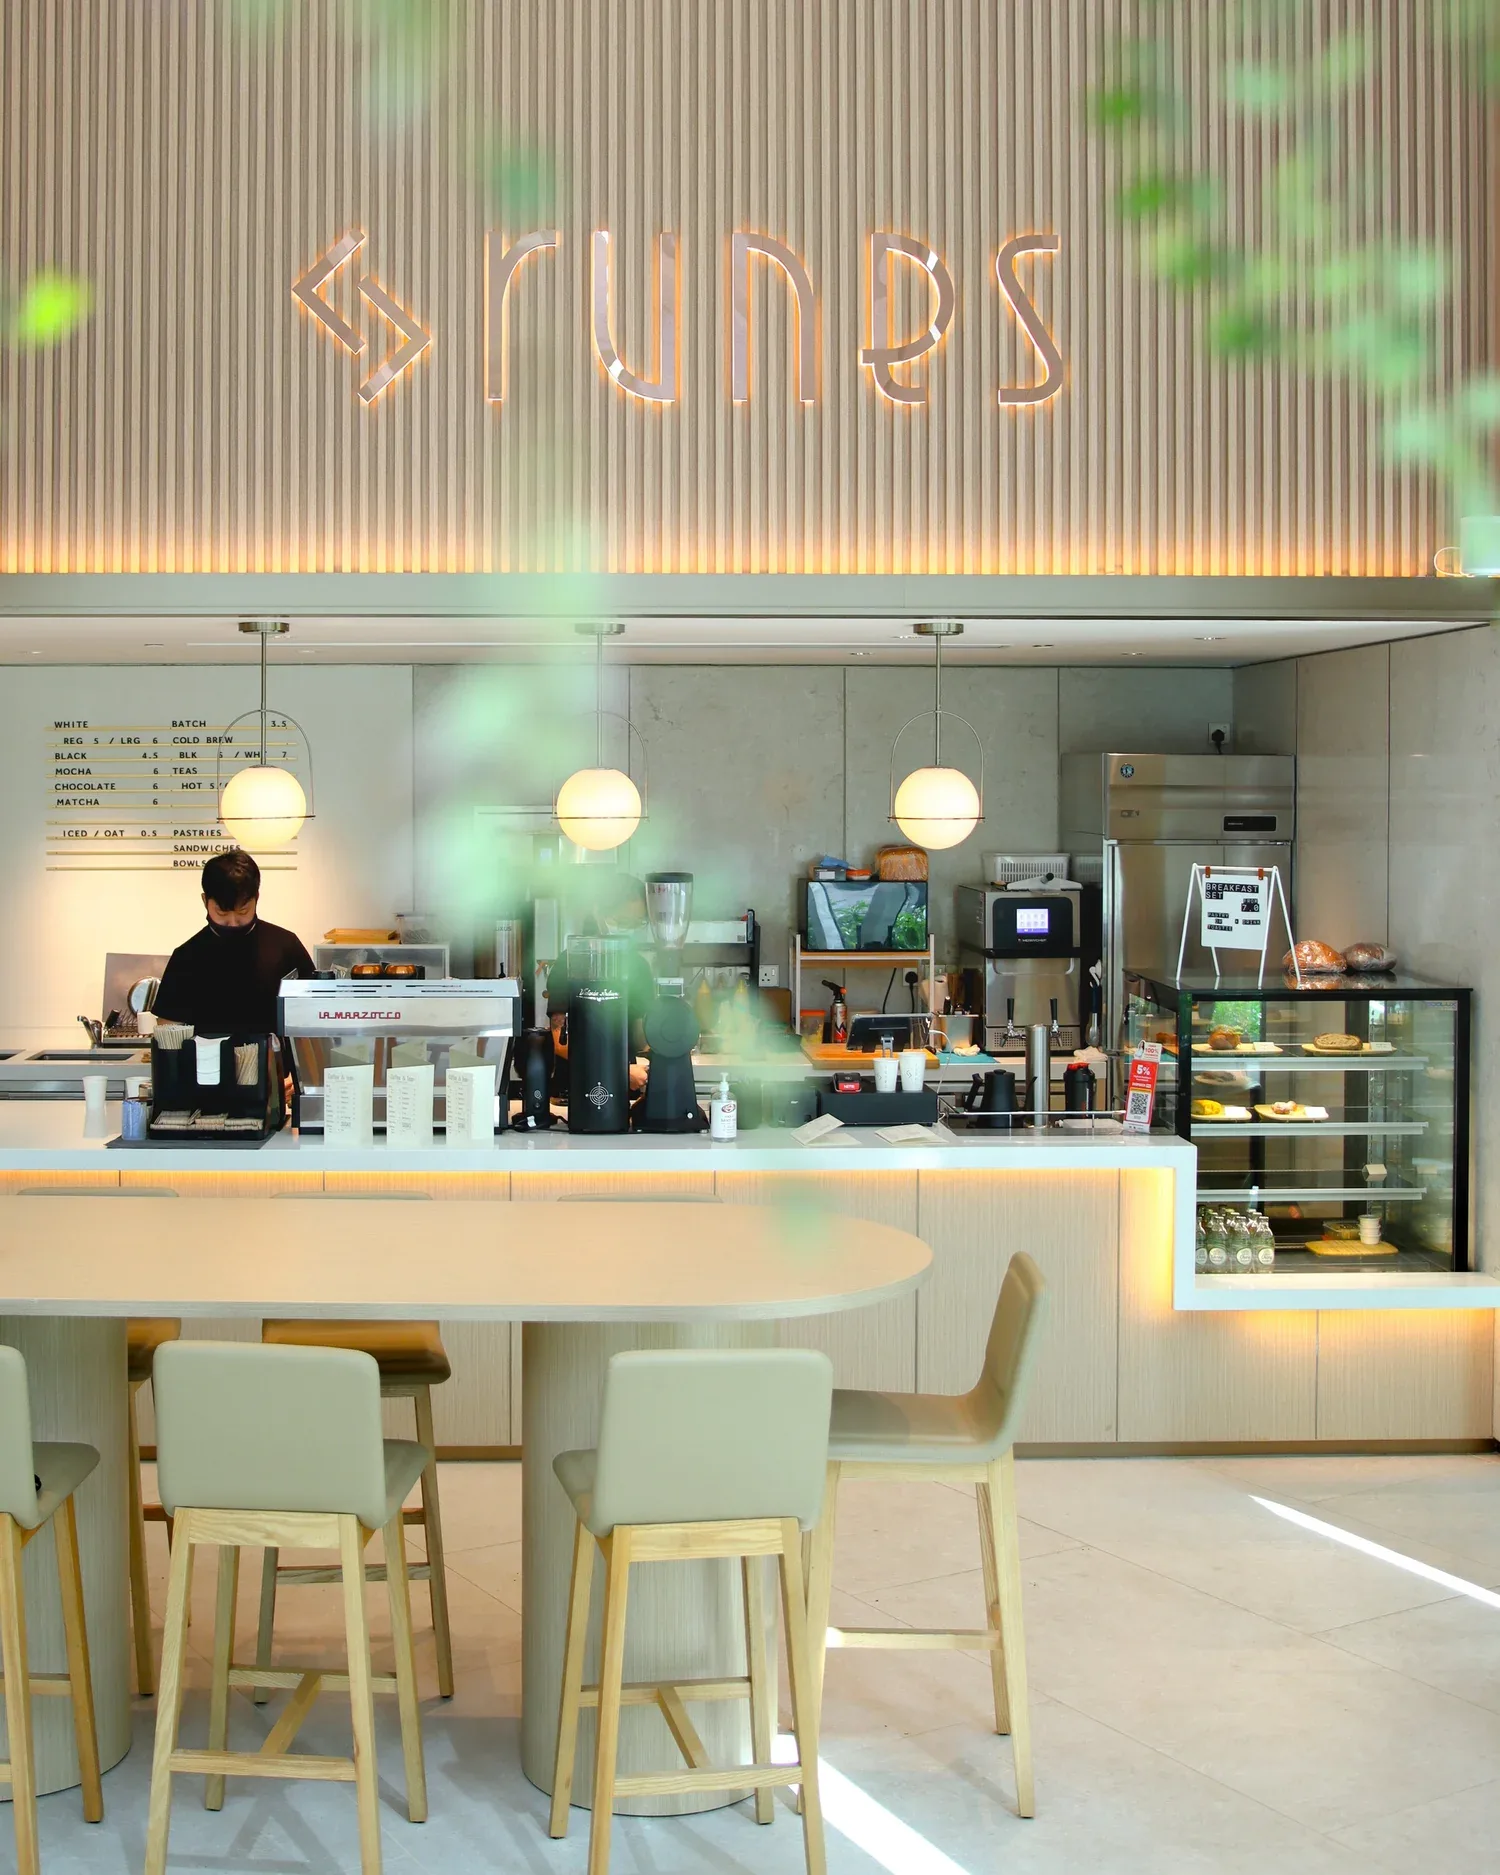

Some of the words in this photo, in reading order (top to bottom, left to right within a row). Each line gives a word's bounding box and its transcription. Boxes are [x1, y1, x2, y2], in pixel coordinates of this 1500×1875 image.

[173, 736, 200, 744] COLD
[206, 736, 233, 744] BREW
[153, 767, 159, 775] 6
[172, 767, 198, 775] TEAS
[152, 782, 158, 790] 6
[181, 782, 202, 790] HOT
[56, 798, 100, 806] MATCHA
[152, 798, 158, 806] 6
[173, 829, 221, 837] PASTRIES
[173, 844, 240, 852] SANDWICHES
[173, 859, 206, 867] BOWLS
[1206, 883, 1258, 893] BREAKFAST
[1205, 891, 1223, 899] SET
[1241, 903, 1259, 912] 7.0
[318, 1011, 330, 1020] LA
[334, 1011, 401, 1020] MARZOCCO
[1136, 1064, 1151, 1076] 5%
